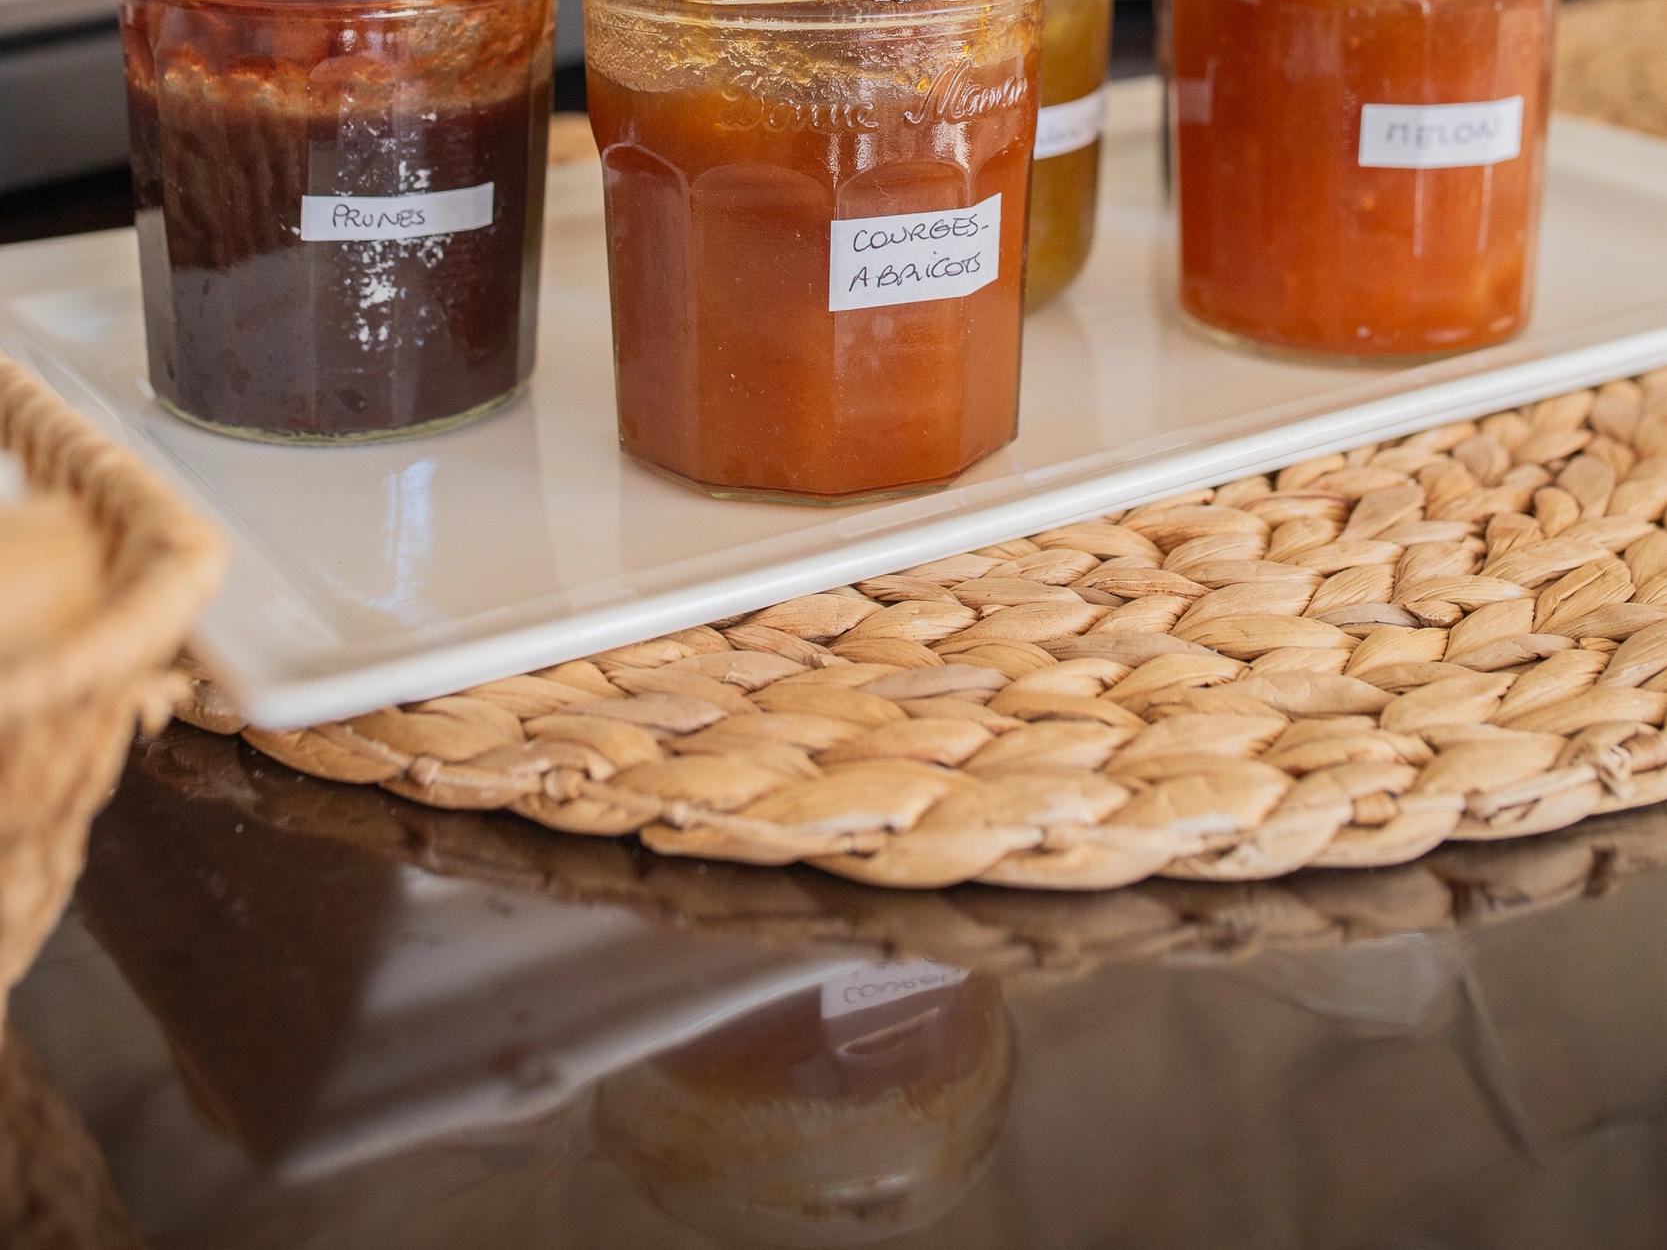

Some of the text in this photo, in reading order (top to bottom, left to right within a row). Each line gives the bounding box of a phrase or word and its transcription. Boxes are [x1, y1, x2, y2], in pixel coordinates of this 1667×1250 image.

[1385, 119, 1502, 148] MELON
[332, 203, 425, 228] PRUNES
[853, 213, 989, 253] COURGES-
